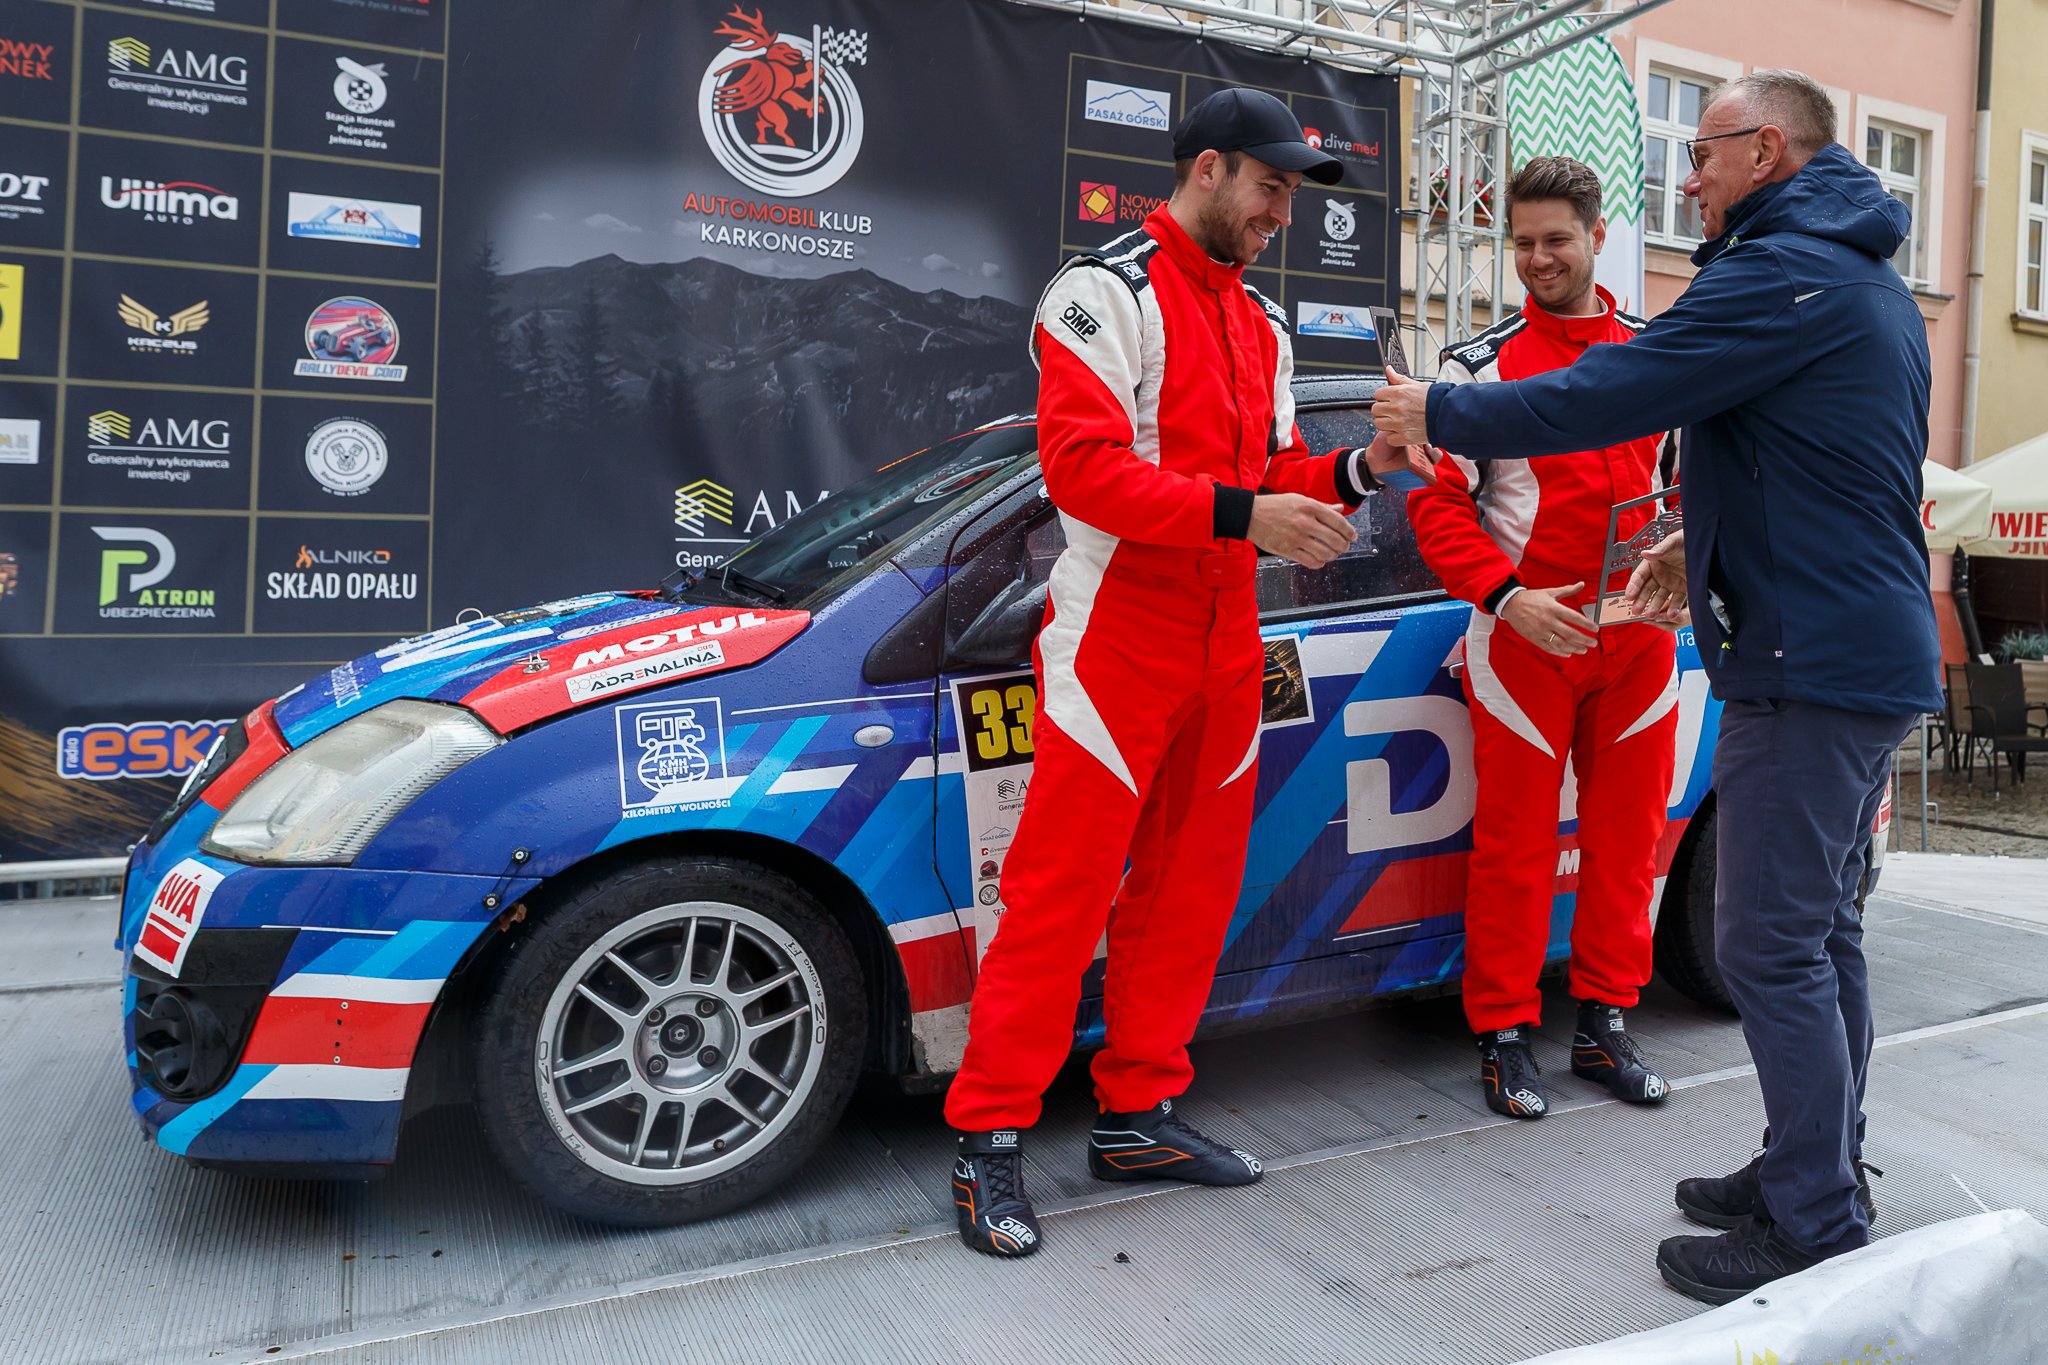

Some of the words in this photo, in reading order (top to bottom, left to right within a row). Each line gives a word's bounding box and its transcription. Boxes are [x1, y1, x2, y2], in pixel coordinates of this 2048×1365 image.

[156, 48, 247, 85] AMG
[108, 77, 174, 98] Generalny
[175, 88, 247, 105] wykonawca
[147, 96, 209, 115] inwestycji
[1087, 106, 1124, 122] PASAŻ
[1125, 112, 1167, 128] GÓRSKI
[325, 111, 355, 124] Stacja
[356, 115, 395, 128] Kontroli
[1324, 133, 1379, 157] divemed
[101, 175, 238, 220] Ultima
[144, 212, 194, 225] AUTO
[683, 193, 873, 235] AUTOMOBILKLUB
[701, 223, 855, 260] KARKONOSZE
[1319, 240, 1337, 249] Stacja
[1337, 242, 1360, 251] Kontroli
[1063, 306, 1097, 336] OMP
[1466, 345, 1492, 362] OMP
[136, 418, 231, 449] AMG
[87, 453, 155, 467] Generalny
[156, 457, 230, 469] wykonawca
[127, 468, 191, 483] inwestycji
[1920, 500, 1936, 530] C
[296, 545, 391, 568] ALNIKO
[267, 571, 341, 599] SKŁAD
[346, 572, 417, 599] OPAŁU
[100, 607, 216, 618] UBEZPIECZENIA
[571, 612, 766, 670] MOTUL
[971, 684, 1036, 760] 33
[66, 737, 79, 768] radio
[659, 758, 687, 769] KMH
[659, 766, 690, 777] REFIT
[622, 806, 677, 819] KILOMETRY
[680, 799, 731, 812] WOLNOŚCI
[803, 958, 822, 997] RACING
[1497, 1030, 1518, 1040] OMP
[542, 1092, 563, 1132] RACING
[1515, 1091, 1542, 1113] OMP
[992, 1134, 1017, 1144] OMP
[999, 1219, 1034, 1245] OMP
